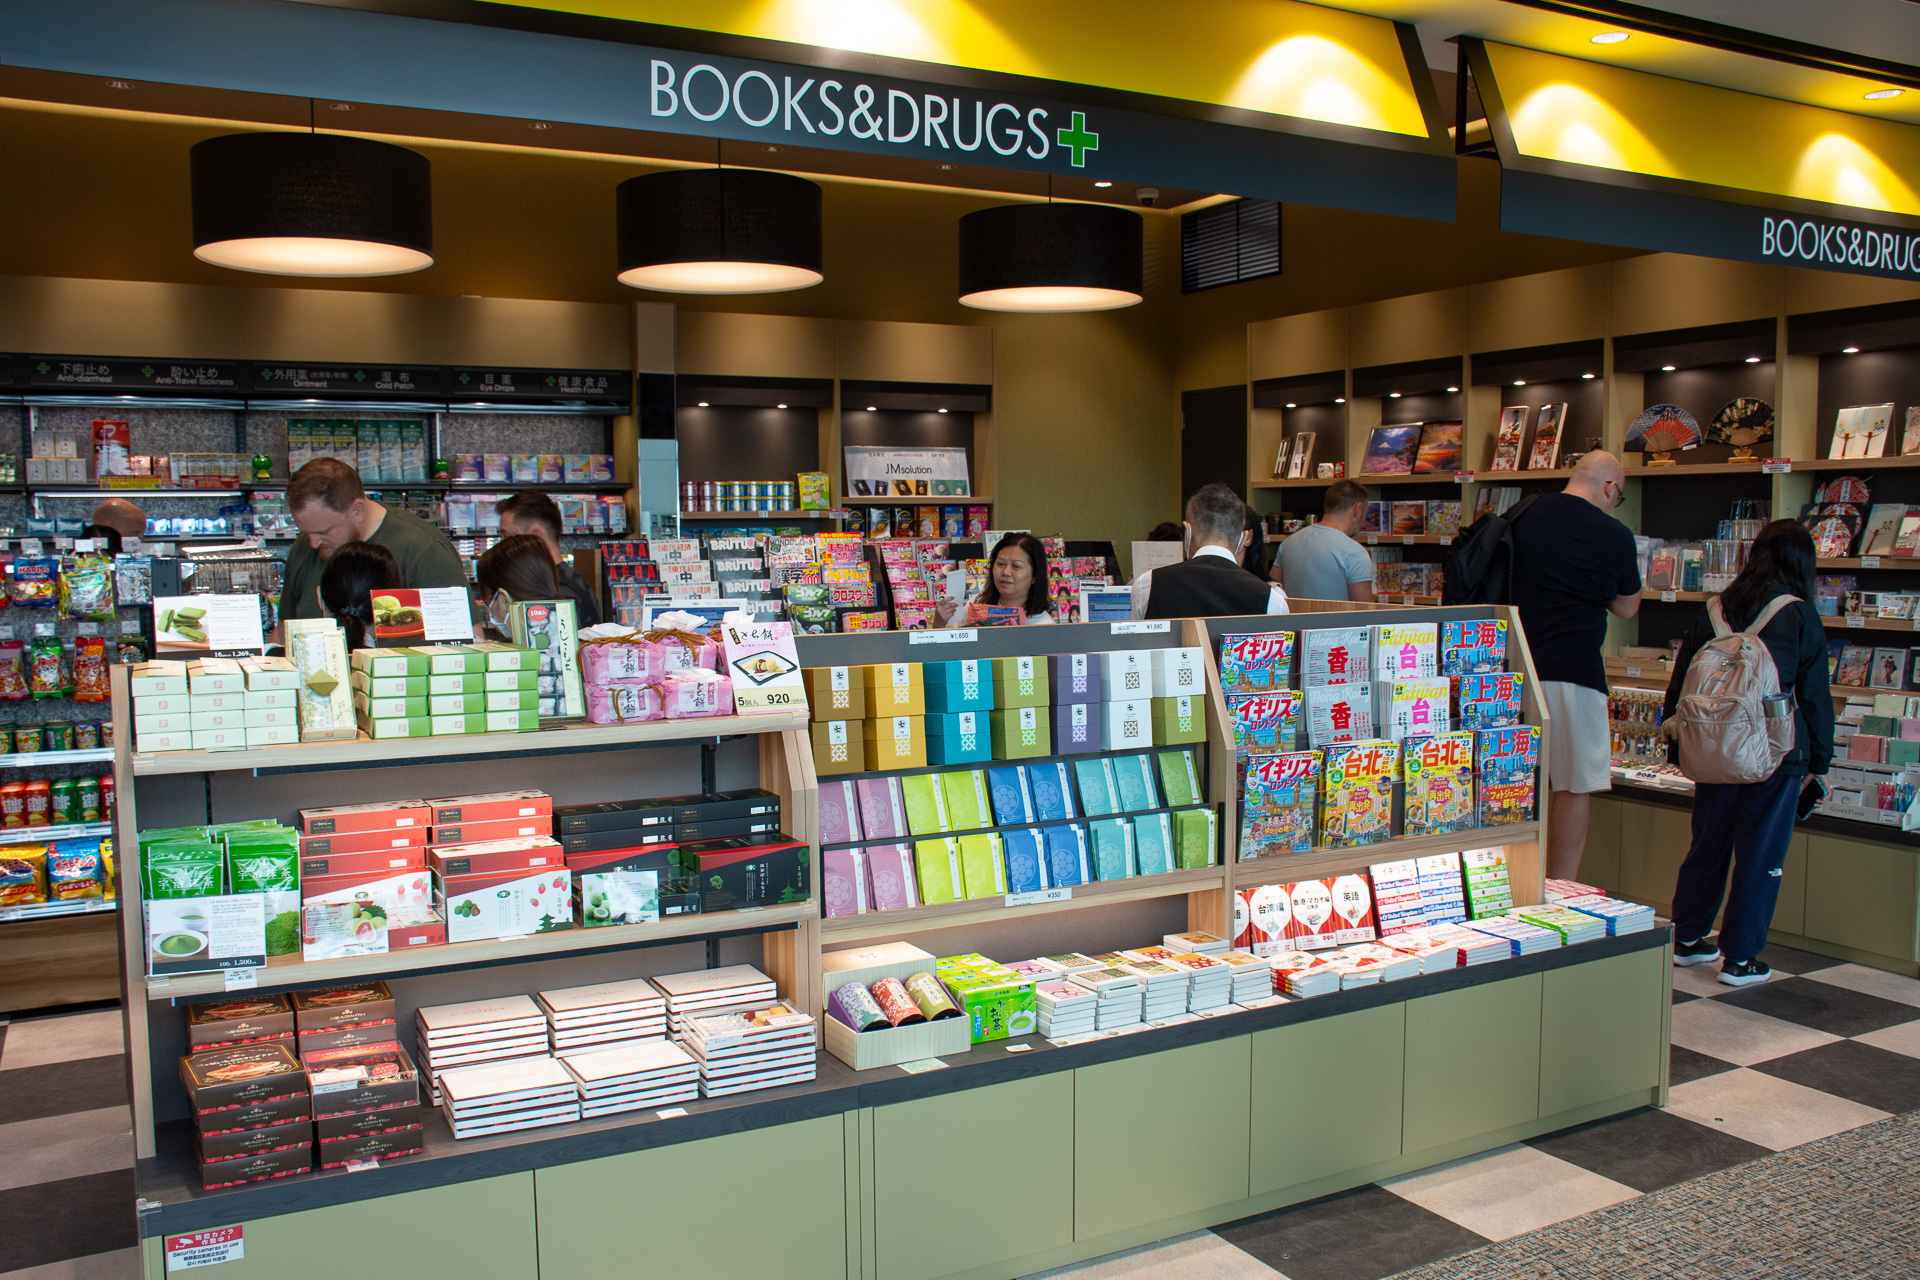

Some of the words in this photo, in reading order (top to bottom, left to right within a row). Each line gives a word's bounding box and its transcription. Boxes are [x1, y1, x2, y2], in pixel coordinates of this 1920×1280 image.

[651, 59, 1050, 160] BOOKS&DRUGS
[171, 366, 219, 378] 酔い止め
[274, 368, 308, 381] 外用薬
[57, 374, 113, 384] Anti-diarrheal
[156, 376, 197, 386] Anti-Travel
[198, 377, 234, 387] Sickness
[294, 380, 327, 388] Ointment
[375, 381, 393, 390] Cold
[395, 382, 414, 390] Patch
[480, 384, 493, 393] Eye
[494, 384, 515, 393] Drops
[561, 386, 581, 395] Health
[583, 386, 604, 395] Foods
[885, 463, 933, 475] JMsolution
[601, 543, 646, 559] AERA
[610, 564, 655, 581] AERA
[680, 571, 692, 582] 中
[776, 569, 802, 584] 漢字
[832, 588, 874, 602] クロスワード
[1380, 626, 1436, 647] Taiwan
[1453, 622, 1497, 649] 上海
[1233, 638, 1286, 662] イギリス
[1245, 660, 1272, 672] ロンドン
[1400, 643, 1419, 680] 台
[1392, 682, 1449, 703] Taiwan
[1471, 676, 1515, 703] 上海
[767, 693, 790, 704] 920
[1238, 698, 1293, 723] イギリス
[1411, 697, 1430, 736] 台
[1251, 719, 1278, 731] ロンドン
[1491, 729, 1532, 758] 上海
[1422, 739, 1461, 768] 台北
[1344, 749, 1385, 778] 台北
[1259, 758, 1313, 783] イギリス
[1270, 779, 1299, 792] ロンドン
[3, 797, 23, 807] chip
[27, 796, 47, 807] chip
[27, 803, 48, 812] star
[3, 804, 24, 814] star
[1829, 806, 1865, 817] GreenFlash
[1343, 891, 1360, 902] 英語
[172, 1249, 197, 1258] Security
[198, 1245, 222, 1254] cameras
